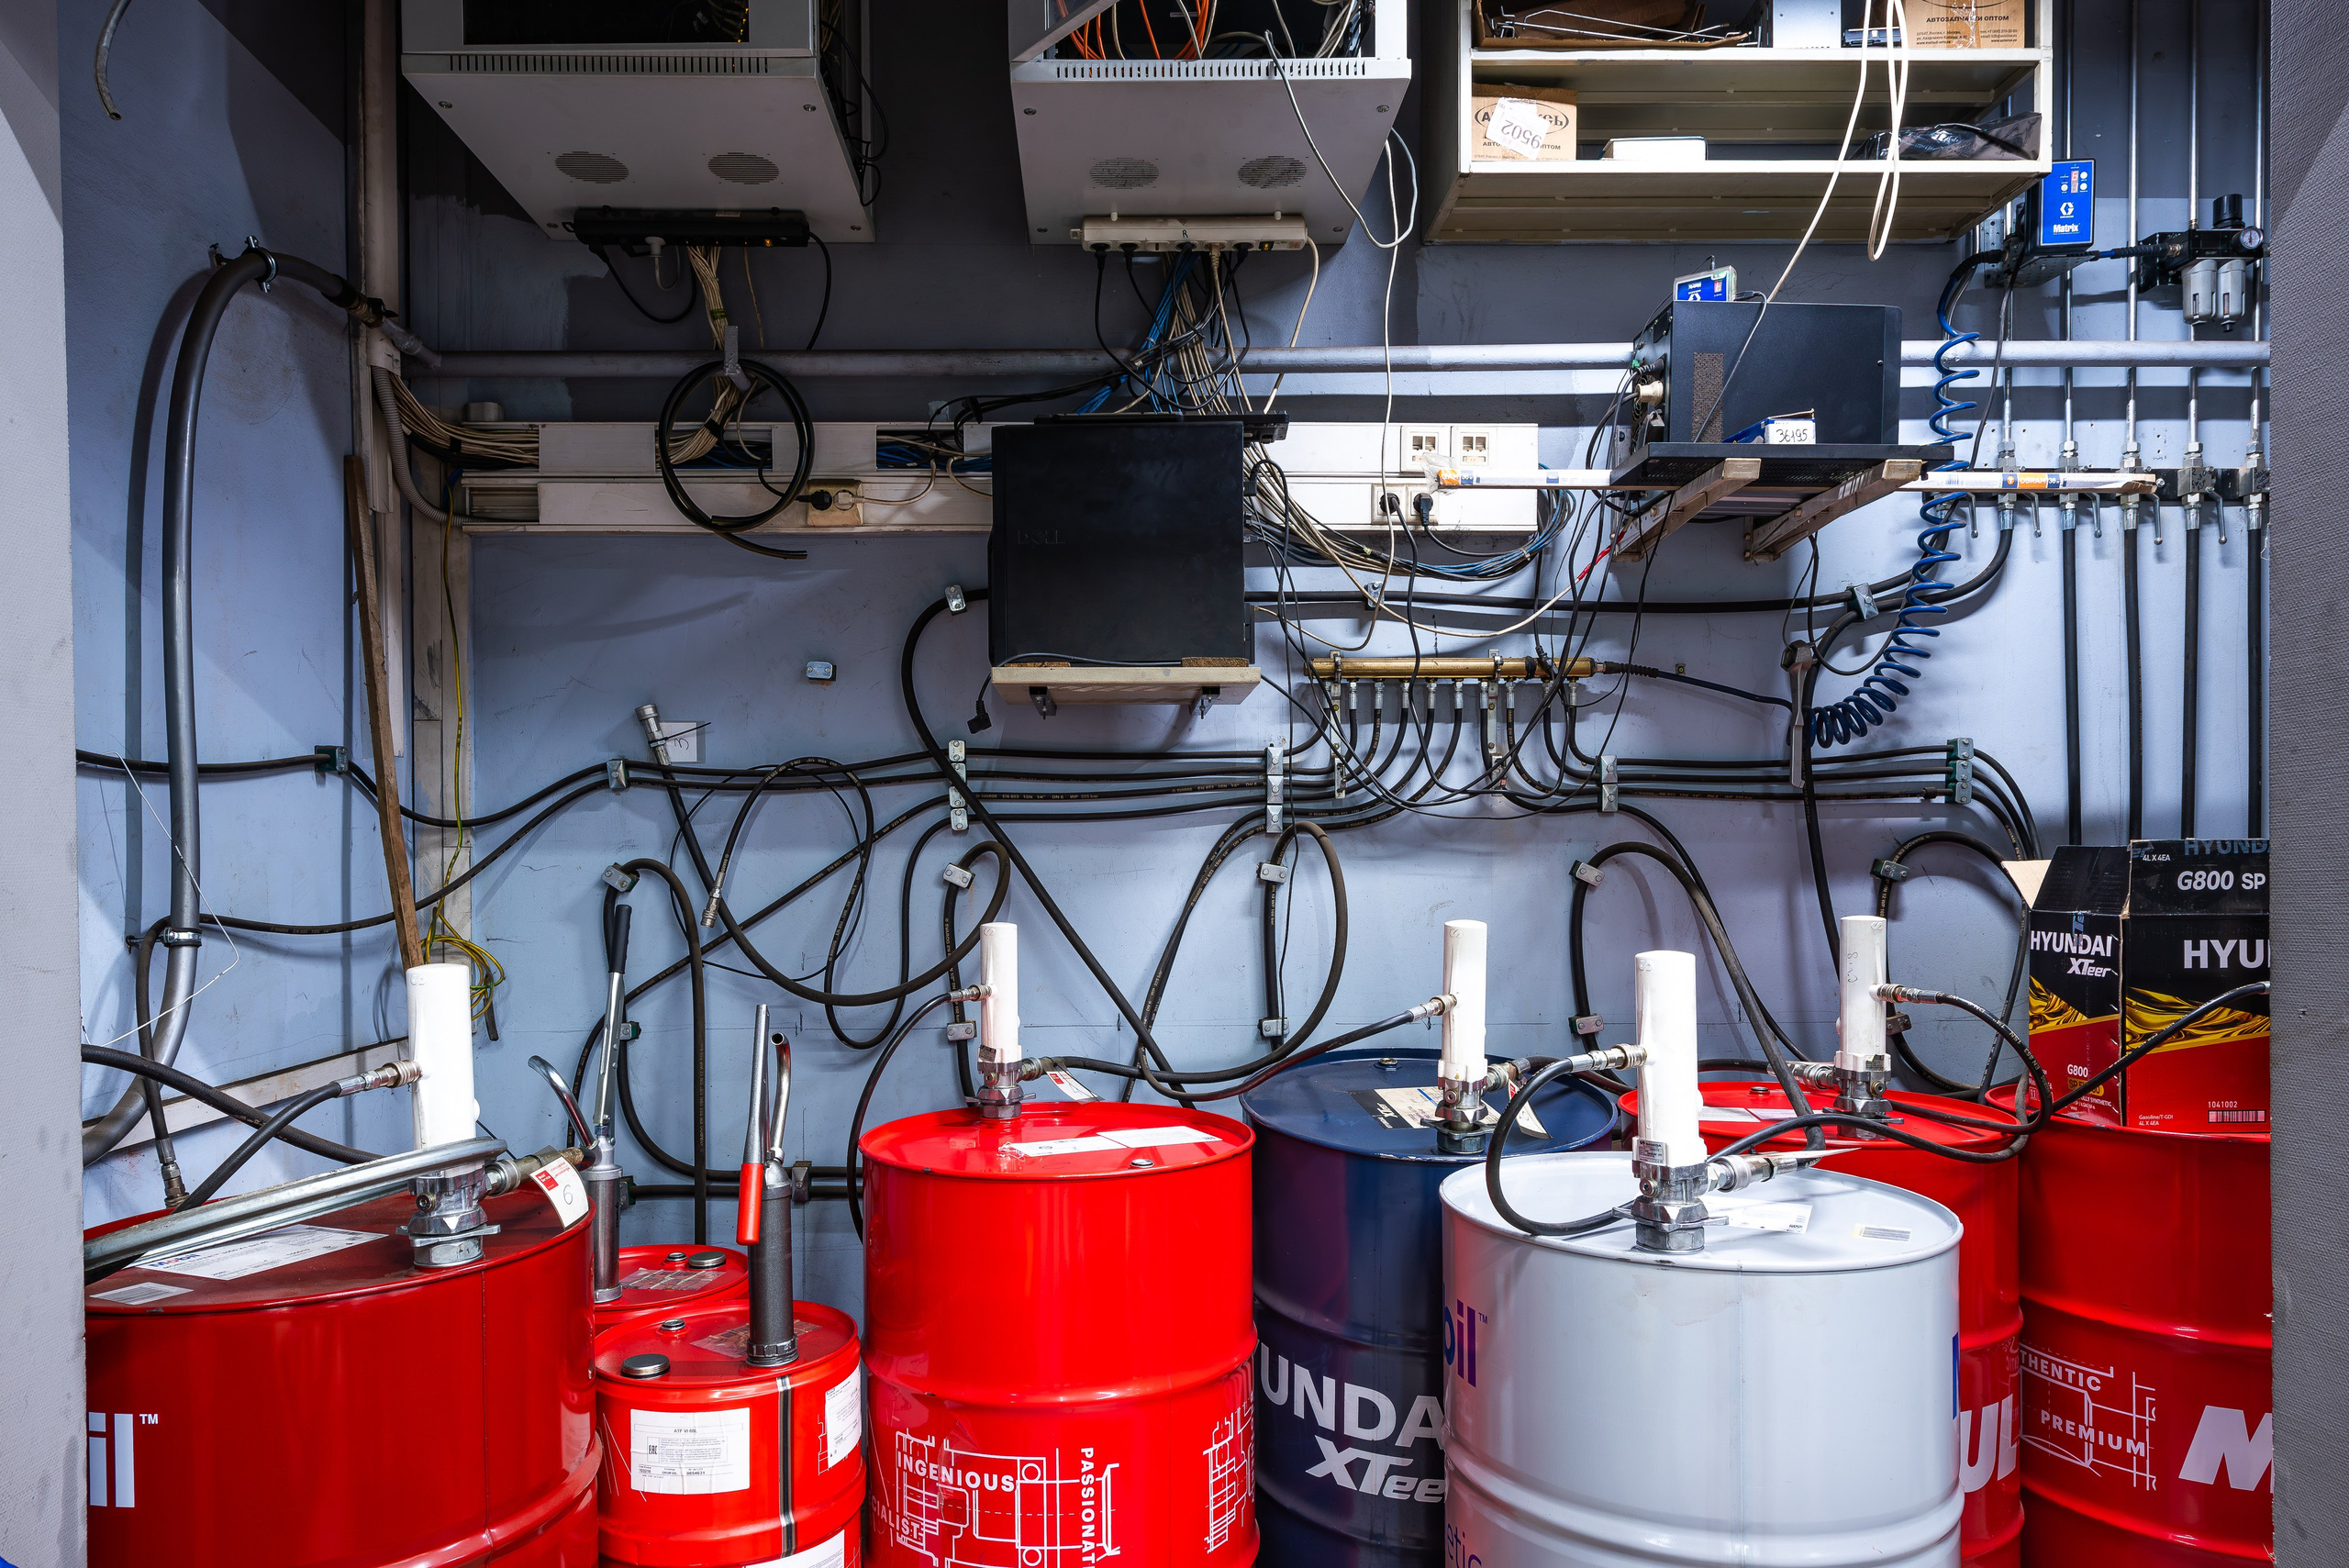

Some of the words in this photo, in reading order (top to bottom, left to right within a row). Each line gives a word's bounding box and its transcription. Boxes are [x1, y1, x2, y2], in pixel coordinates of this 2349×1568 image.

[1183, 229, 1188, 239] R
[2053, 224, 2078, 233] Matrix
[1776, 428, 1808, 442] 36195
[2184, 840, 2270, 856] HYUND
[2176, 870, 2234, 890] G800
[2241, 873, 2266, 890] SP
[2030, 930, 2113, 957] HYUNDAI
[2184, 939, 2270, 969] HYU
[2066, 957, 2111, 977] XTeer
[2023, 1048, 2034, 1061] 853
[2032, 1060, 2040, 1071] EN
[2067, 1063, 2088, 1078] G800
[2208, 1100, 2237, 1108] 1041002
[562, 1184, 573, 1205] 6
[1260, 1340, 1445, 1450] UNDA
[139, 1413, 159, 1425] TM
[2041, 1409, 2145, 1457] PREMIUM
[897, 1451, 1015, 1493] INGENIOUS
[1080, 1447, 1096, 1568] PASSIONAT
